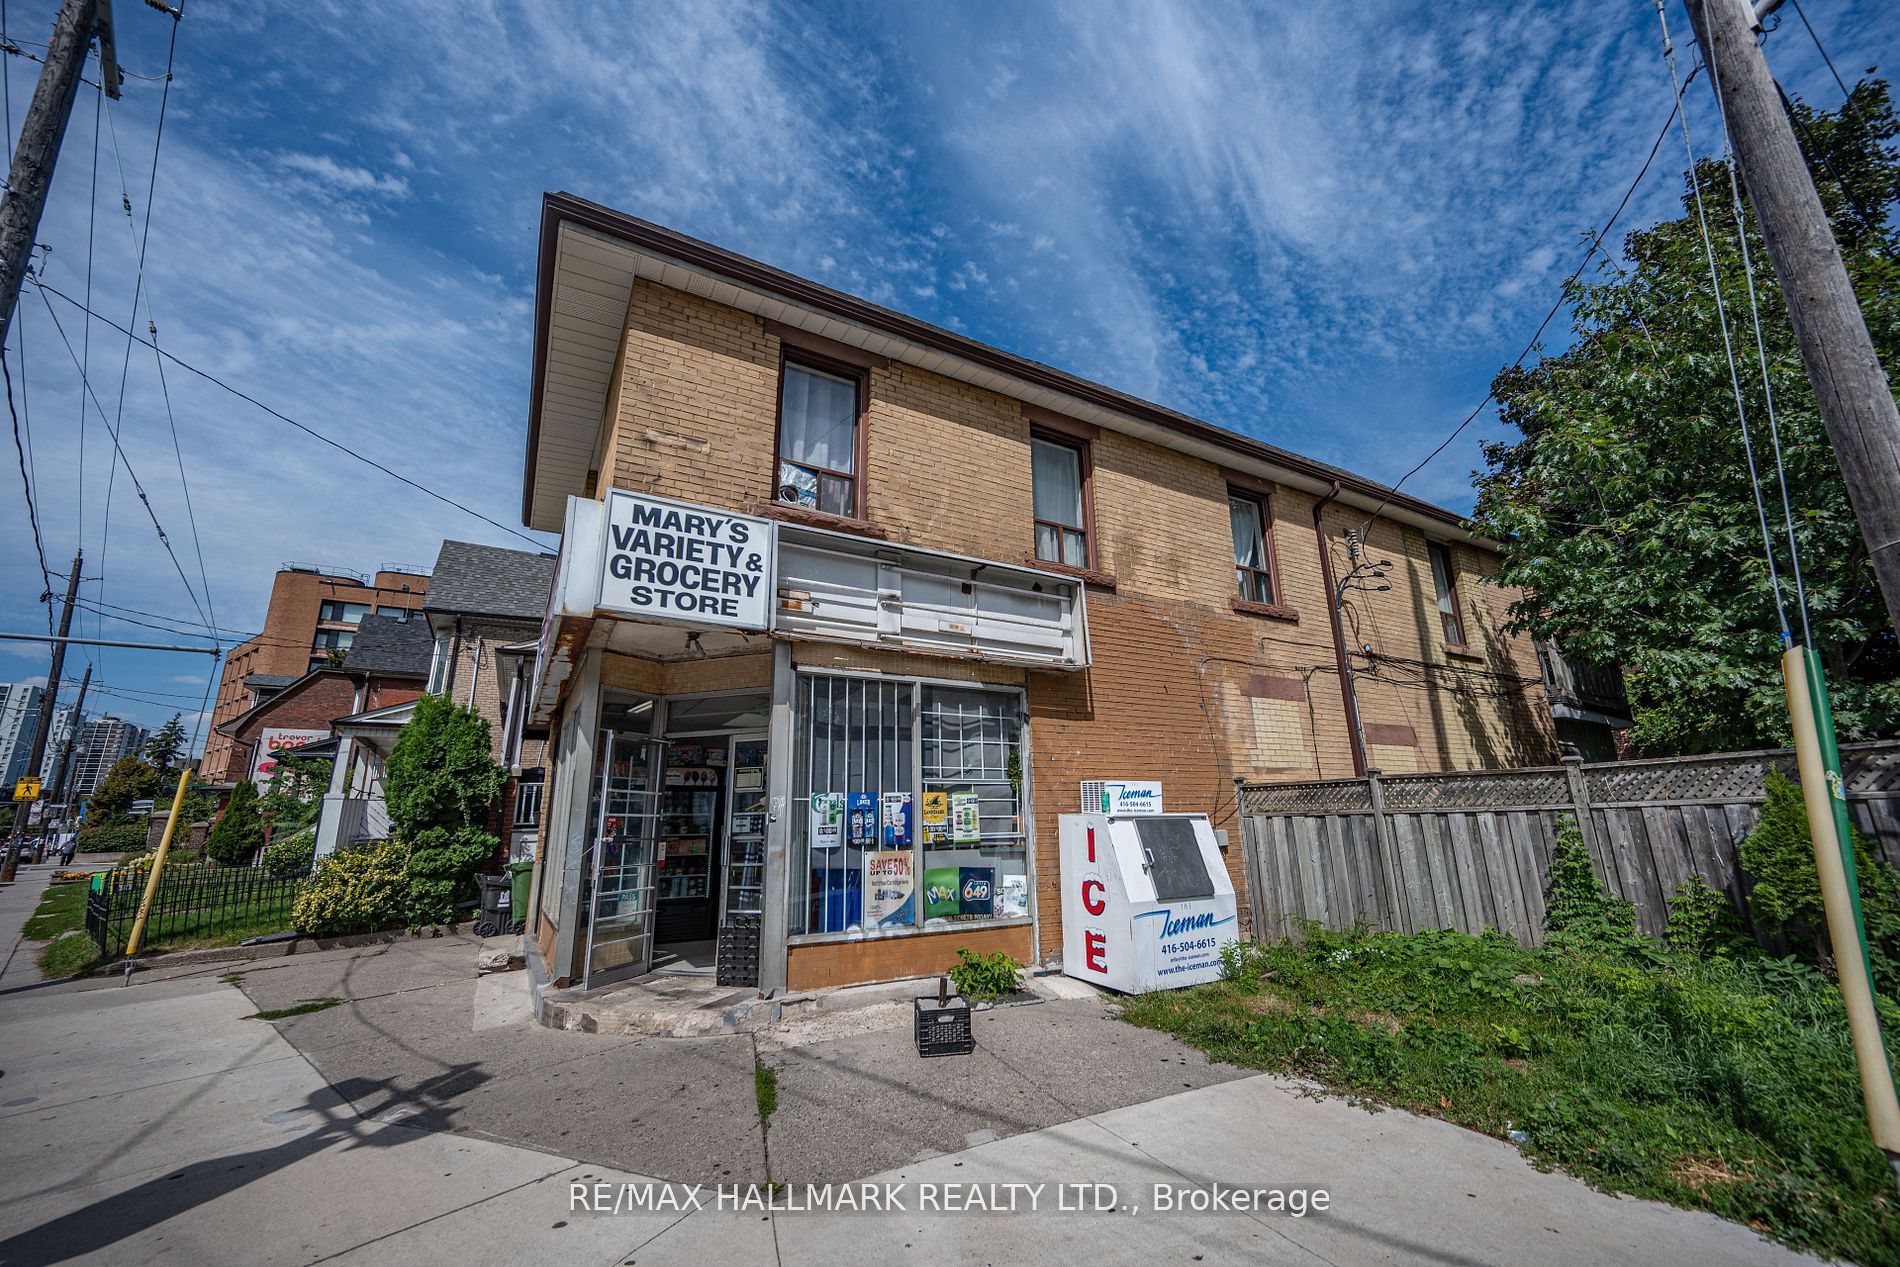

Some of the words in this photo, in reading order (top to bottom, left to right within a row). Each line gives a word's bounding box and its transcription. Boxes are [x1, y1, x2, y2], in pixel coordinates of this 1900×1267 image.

[632, 503, 749, 544] MARY'S
[611, 524, 744, 568] VARIETY
[745, 552, 763, 573] &
[609, 553, 760, 598] GROCERY
[630, 585, 739, 618] STORE
[278, 732, 313, 741] trevor
[1105, 784, 1162, 801] Iceman
[869, 859, 894, 871] SAVE
[893, 857, 911, 876] 50%
[621, 893, 636, 901] PASS
[1133, 909, 1236, 941] Iceman
[1161, 937, 1216, 955] 416-504-6615
[1157, 958, 1223, 977] www.the-iceman.com
